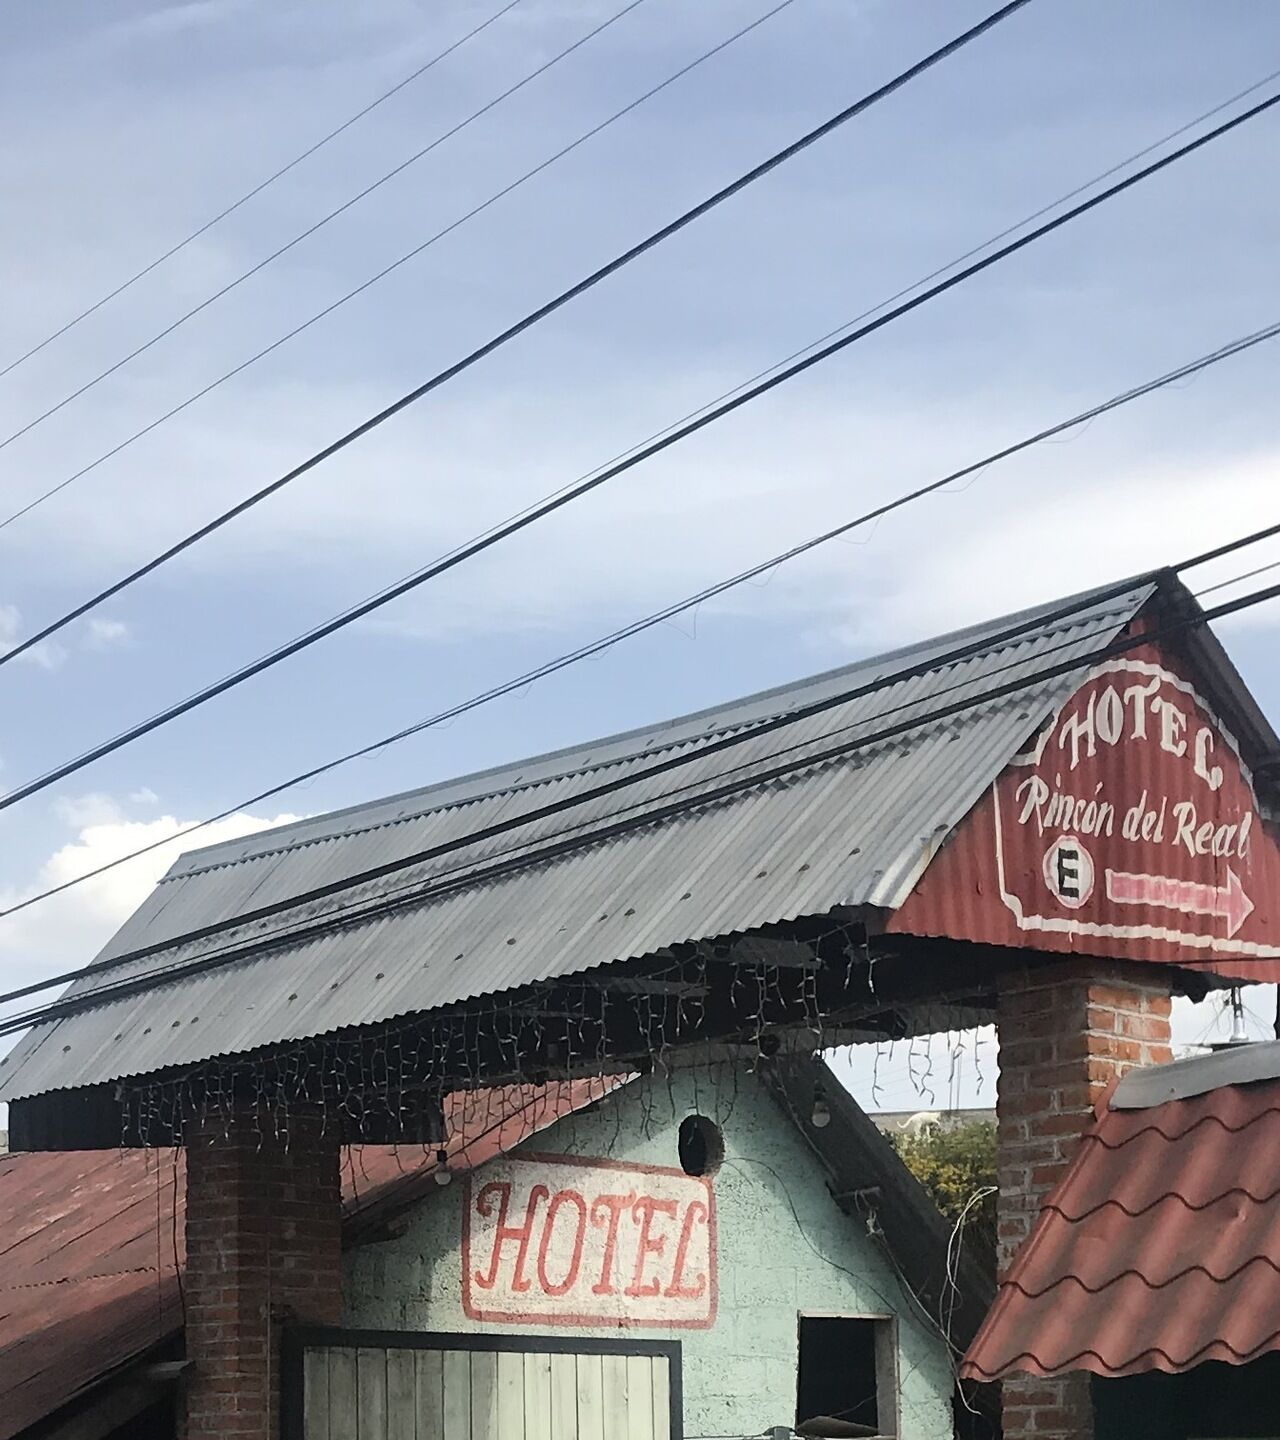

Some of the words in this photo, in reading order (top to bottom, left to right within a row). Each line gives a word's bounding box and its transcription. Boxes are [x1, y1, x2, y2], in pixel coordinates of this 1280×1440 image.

[1058, 676, 1224, 791] HOTEL
[1016, 773, 1115, 838] Rincón
[1122, 789, 1167, 844] del
[1171, 801, 1253, 860] Real
[1058, 847, 1080, 900] E
[474, 1181, 708, 1298] HOTEL
